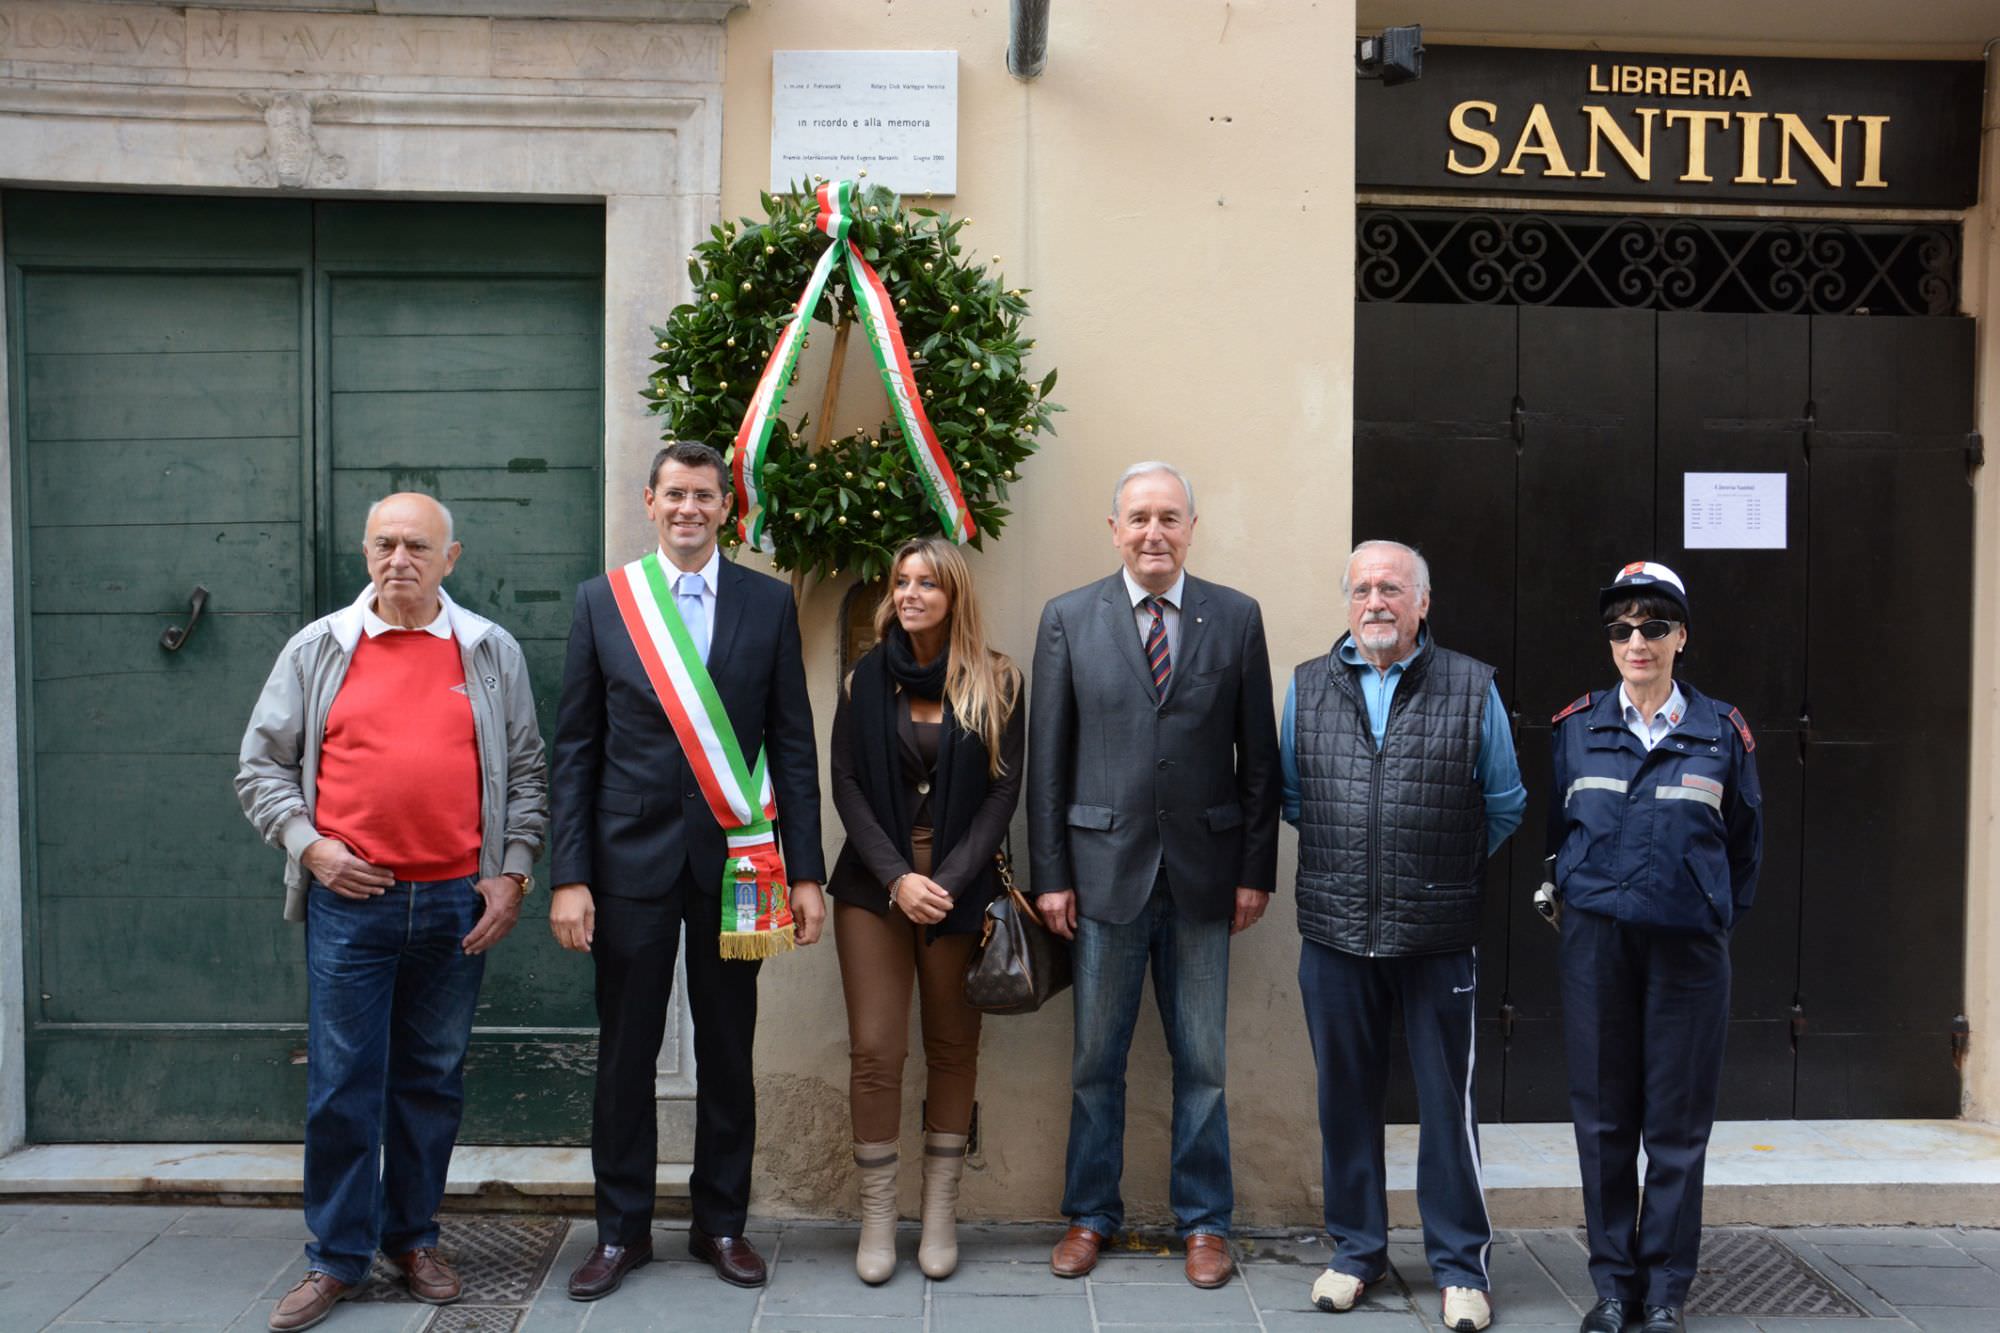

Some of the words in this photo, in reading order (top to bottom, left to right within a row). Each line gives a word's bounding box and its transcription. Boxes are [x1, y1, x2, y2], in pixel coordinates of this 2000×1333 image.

[1588, 64, 1753, 98] LIBRERIA
[797, 118, 807, 128] in
[813, 116, 848, 128] ricordo
[852, 119, 859, 128] e
[864, 116, 882, 128] alla
[887, 118, 931, 128] memoria
[1447, 100, 1890, 189] SANTINI
